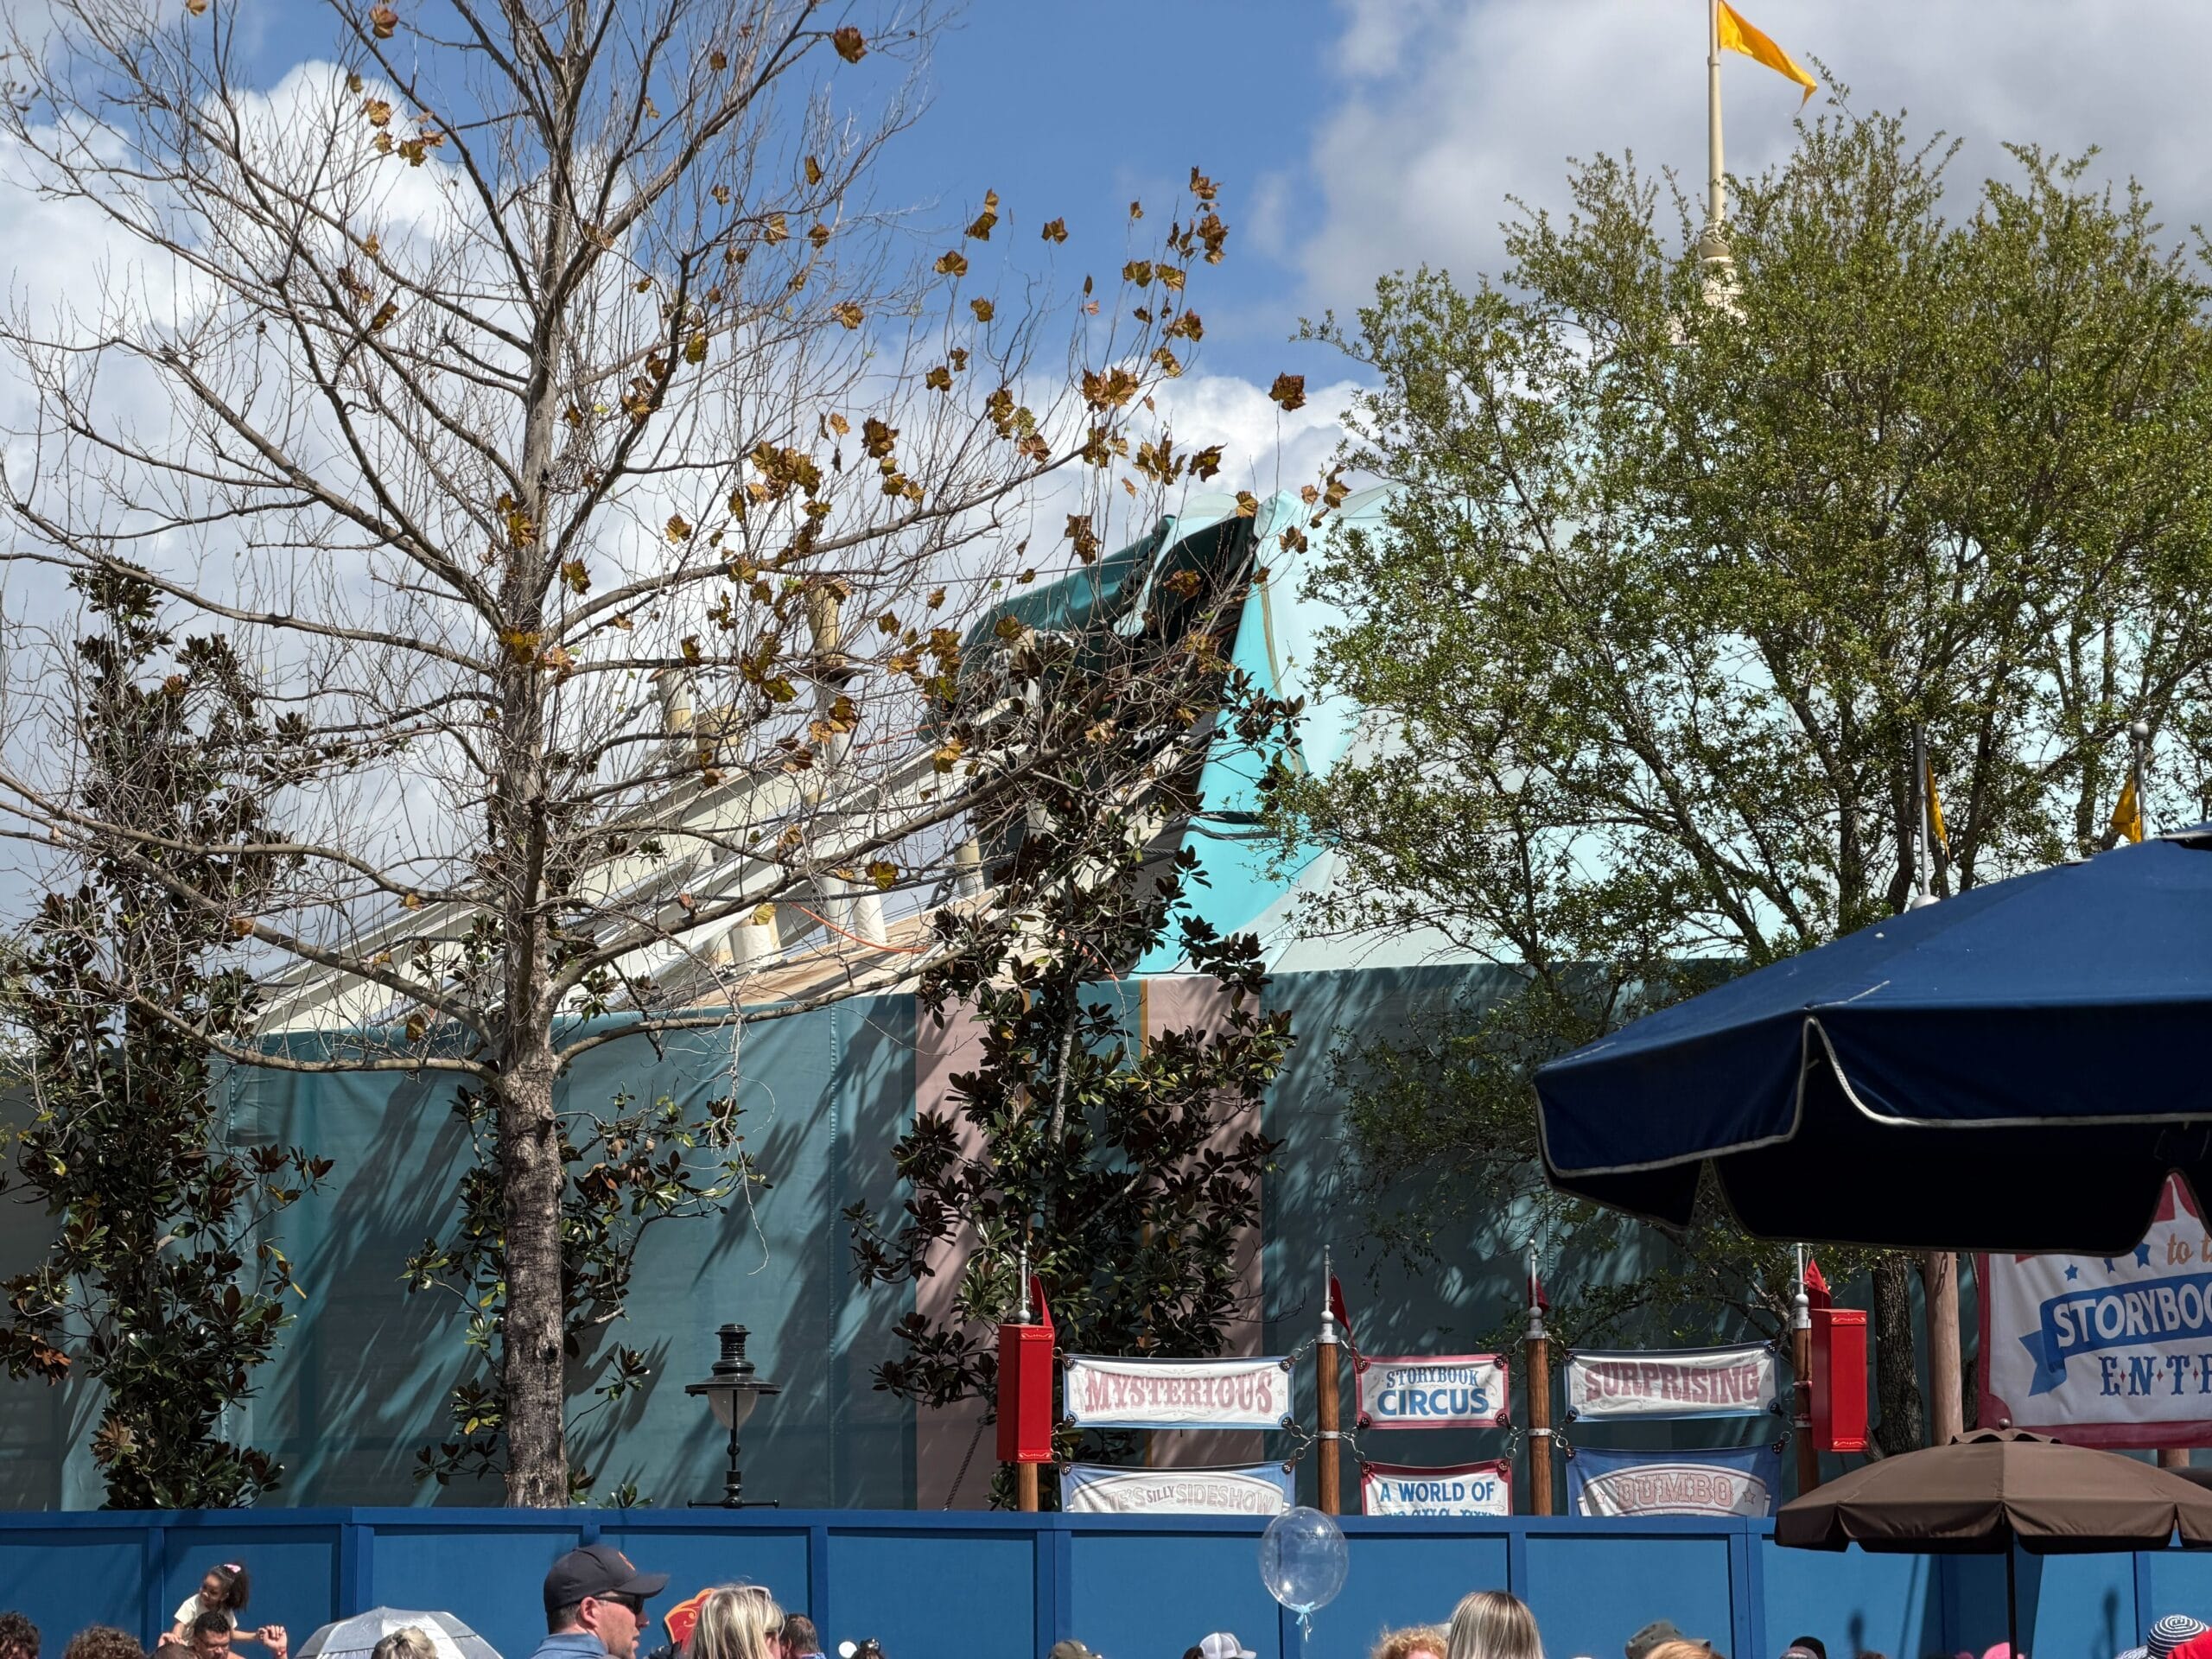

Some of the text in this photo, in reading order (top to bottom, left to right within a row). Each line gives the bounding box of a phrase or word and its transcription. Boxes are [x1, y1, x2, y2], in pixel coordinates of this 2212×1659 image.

[2167, 1232, 2212, 1266] to t
[1084, 1369, 1274, 1414] MYSTERIOUS
[1386, 1366, 1479, 1389] STORYBOOK
[1585, 1361, 1760, 1404] SURPRISING
[1377, 1388, 1490, 1416] CIRCUS
[1146, 1486, 1174, 1503] SILLY
[1176, 1484, 1275, 1513] SIDESHOW
[1380, 1481, 1496, 1503] A WORLD OF
[1615, 1473, 1733, 1510] DUMBO
